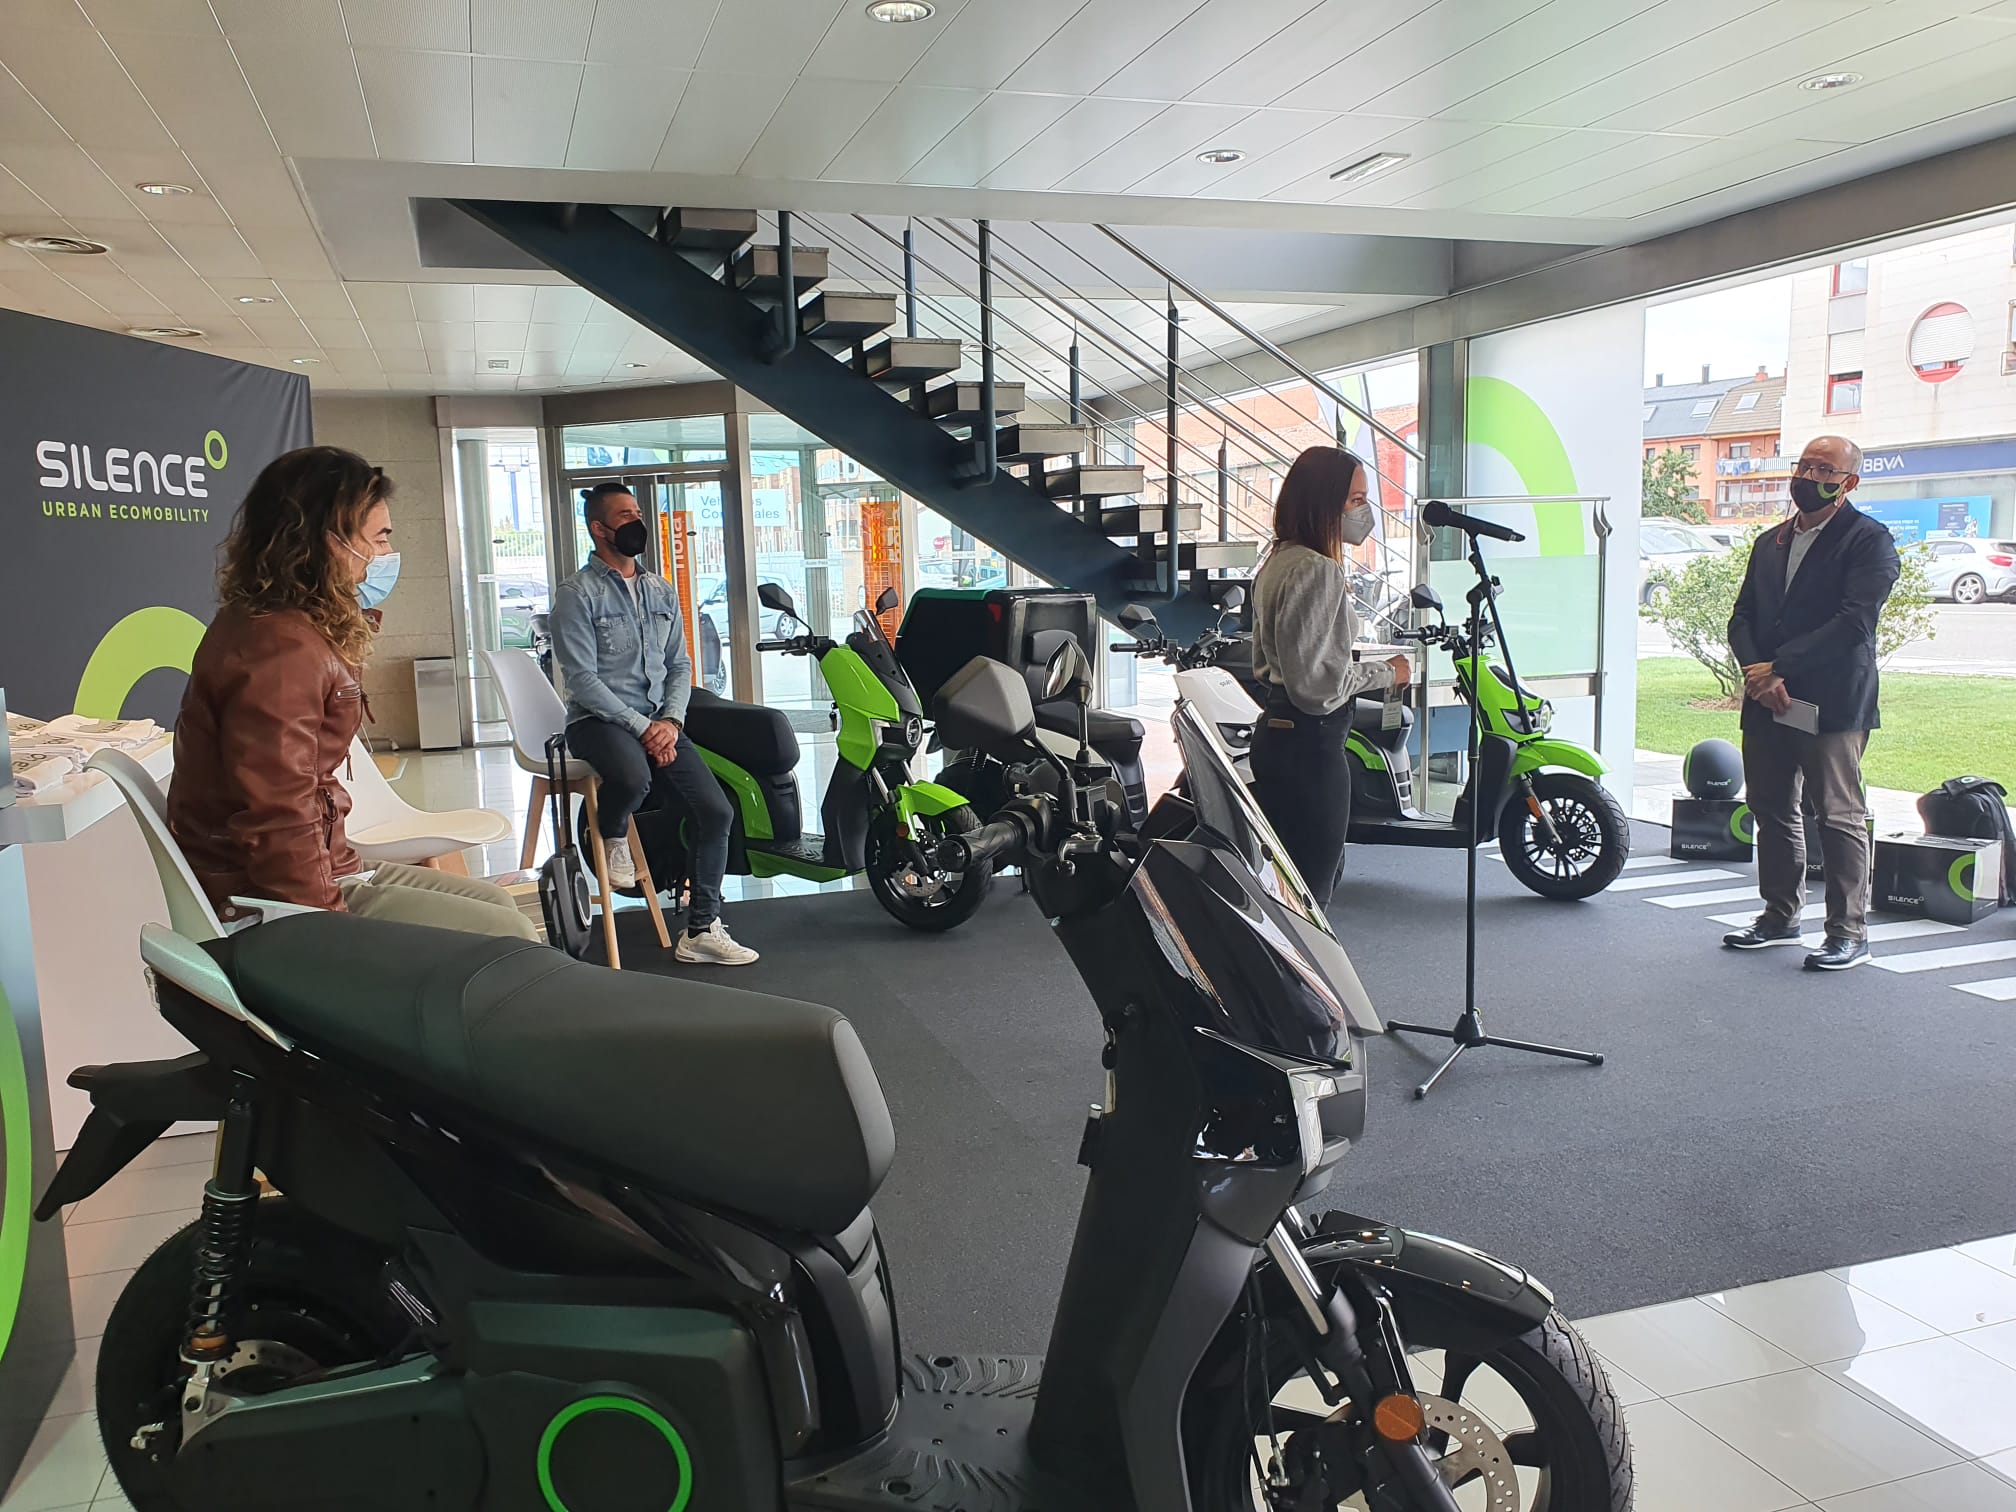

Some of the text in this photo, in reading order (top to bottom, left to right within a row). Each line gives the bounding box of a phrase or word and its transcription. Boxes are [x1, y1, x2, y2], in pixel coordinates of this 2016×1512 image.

[36, 440, 208, 498] SILENCE
[1863, 454, 1904, 473] BBVA
[42, 501, 209, 523] URBAN ECOMOBILITY
[1887, 895, 1919, 905] SILENCE
